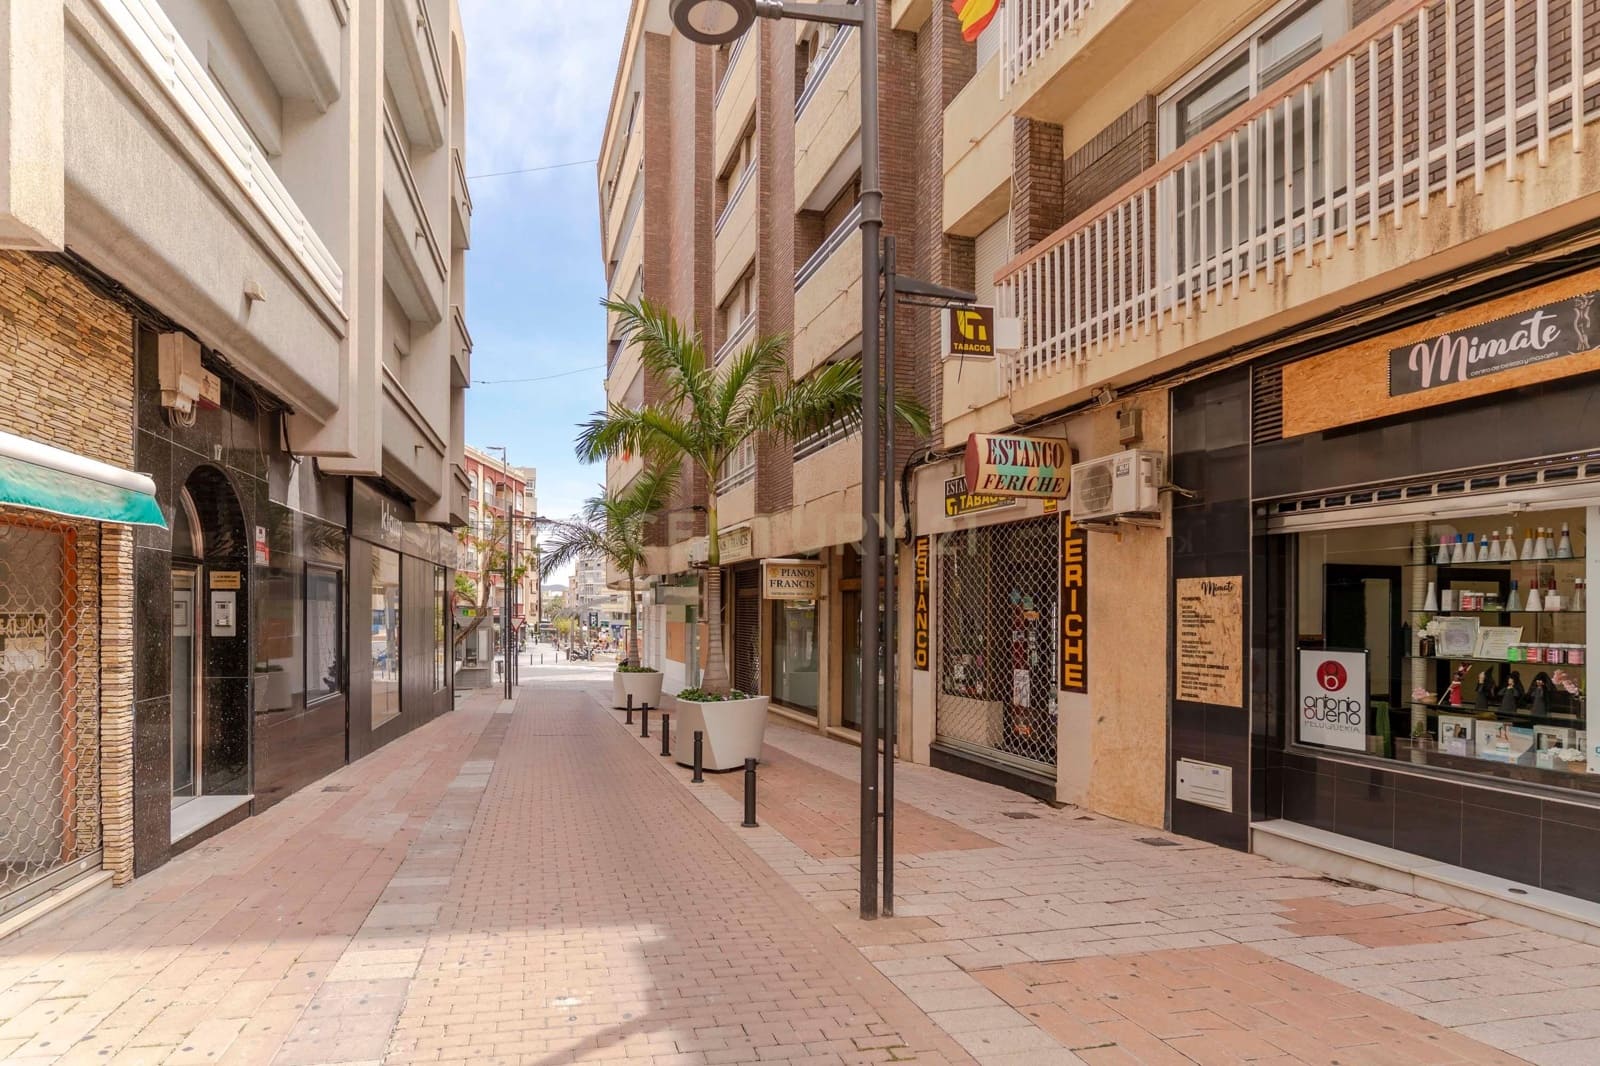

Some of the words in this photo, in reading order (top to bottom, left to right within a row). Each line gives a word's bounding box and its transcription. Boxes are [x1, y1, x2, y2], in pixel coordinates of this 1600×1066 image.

[953, 342, 991, 353] TABACOS
[1408, 310, 1561, 388] Mimate
[985, 438, 1065, 469] ESTANCO
[983, 474, 1065, 493] FERICHE
[781, 568, 815, 577] PIANOS
[769, 579, 815, 589] FRANCIS
[916, 538, 928, 667] ESTANCO
